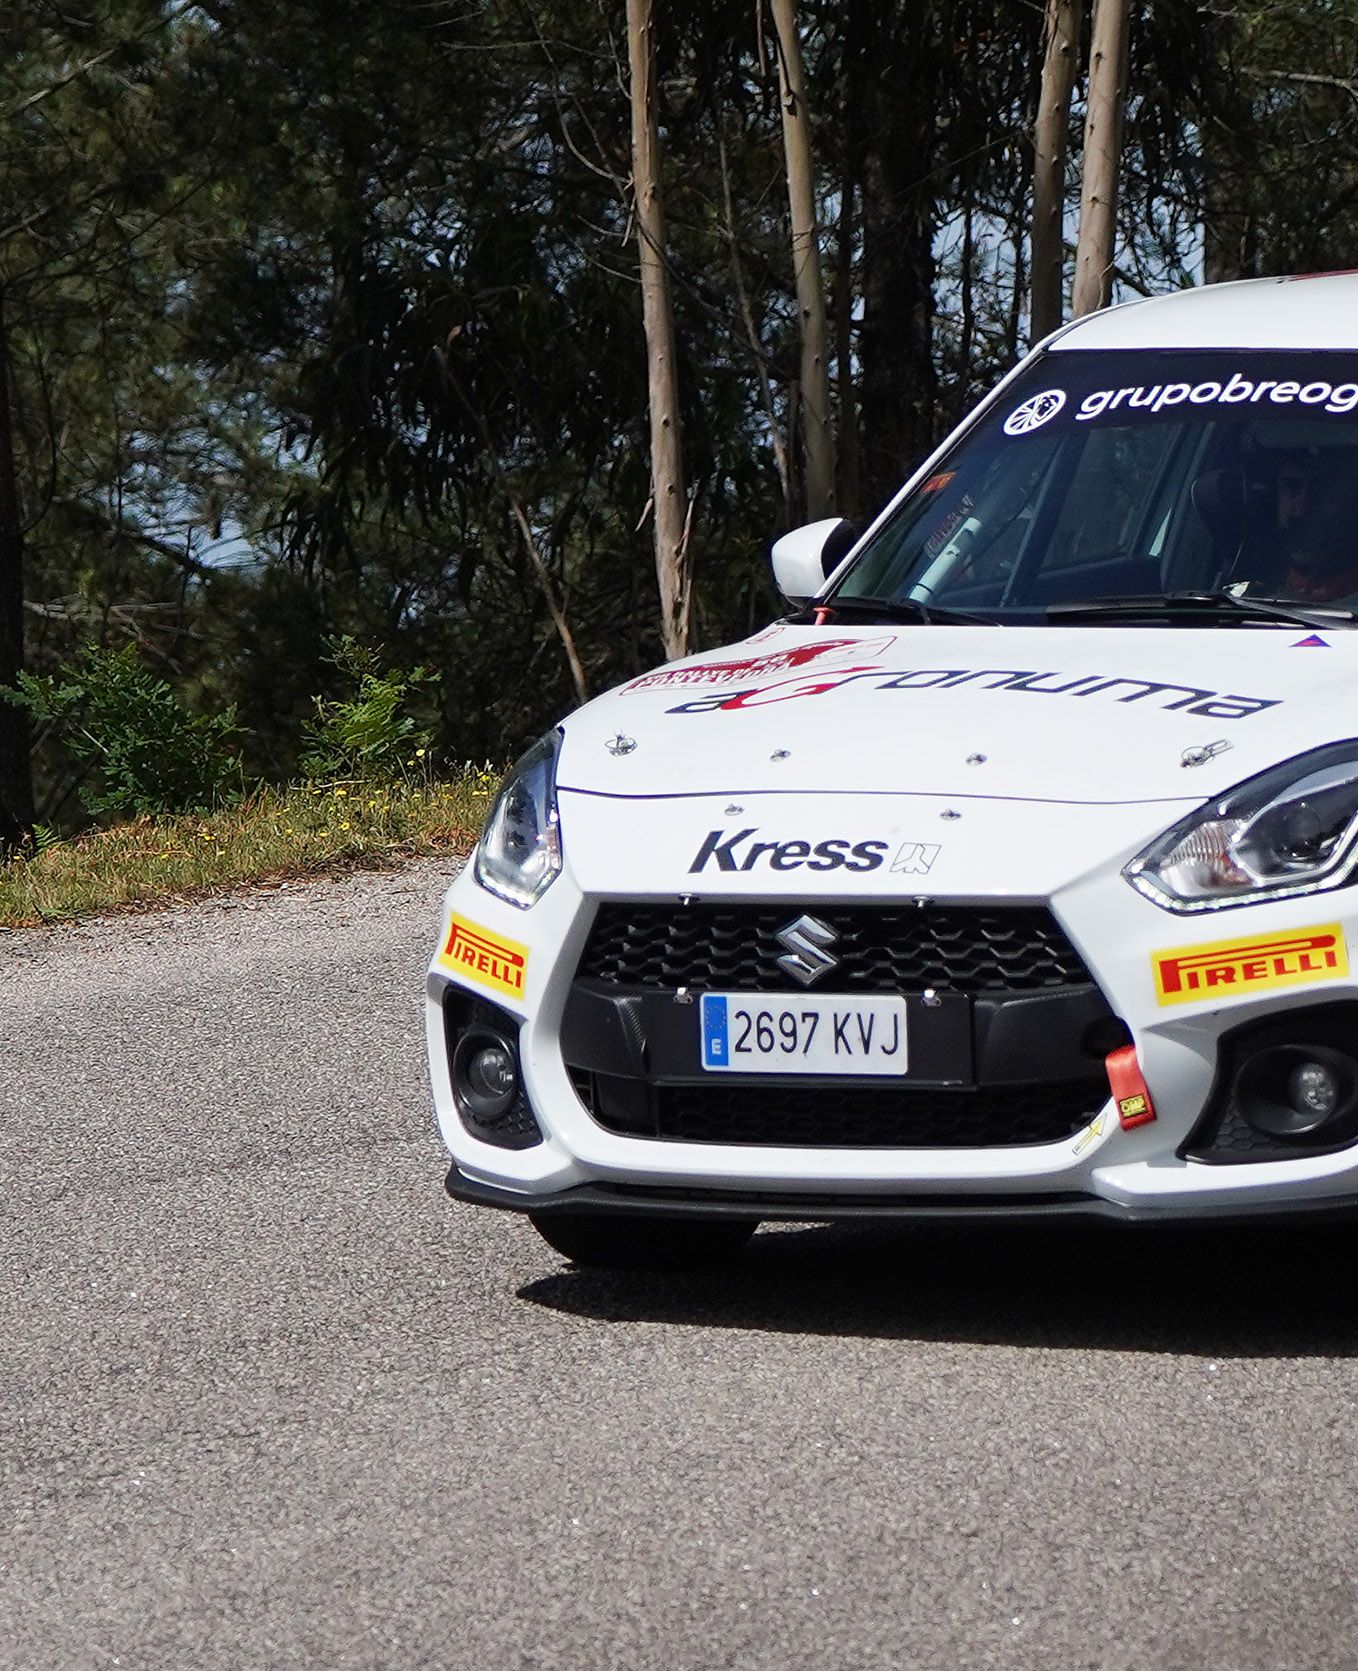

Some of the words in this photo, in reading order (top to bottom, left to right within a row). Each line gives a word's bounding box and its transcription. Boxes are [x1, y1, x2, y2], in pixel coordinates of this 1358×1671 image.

[688, 827, 889, 874] Kress
[444, 922, 525, 989] PIRELLI
[1158, 933, 1337, 994] PIRELLI
[711, 1038, 722, 1055] E
[734, 1010, 820, 1055] 2697
[833, 1012, 899, 1056] KVJ
